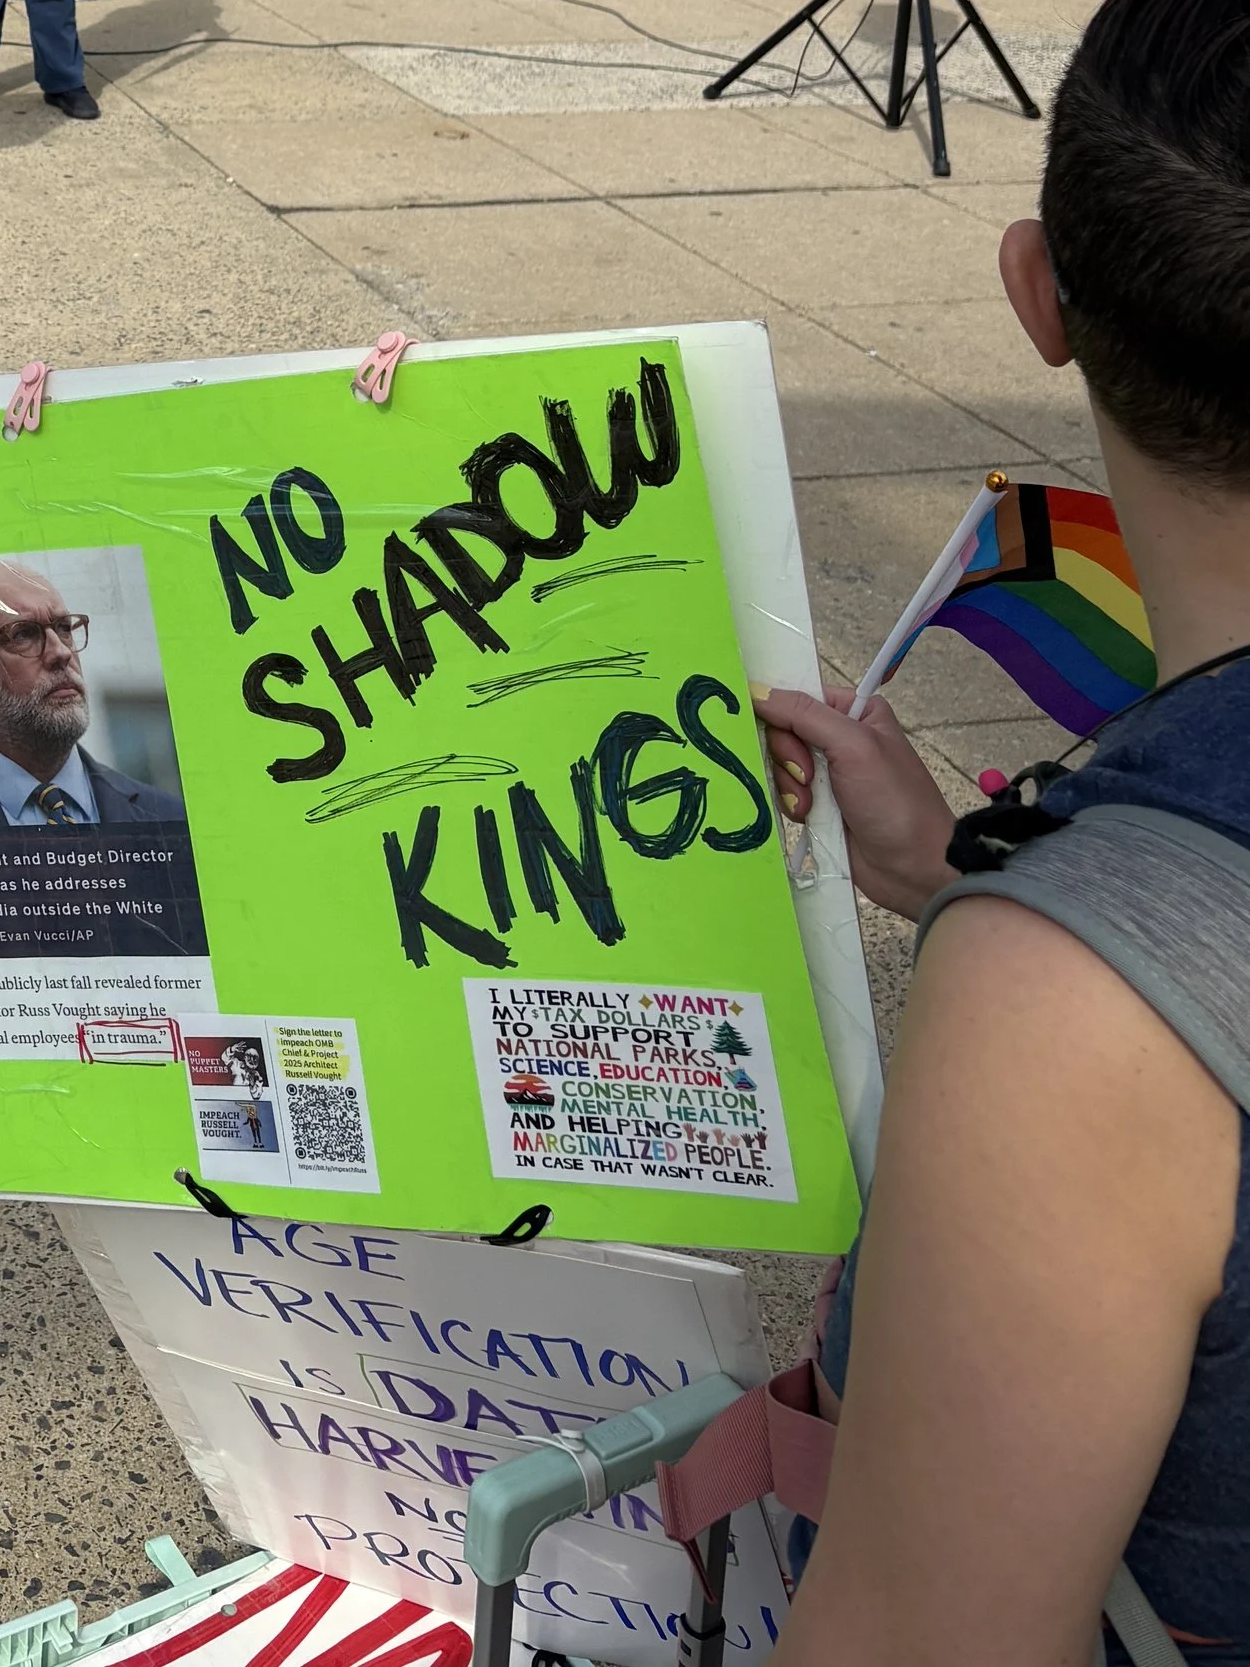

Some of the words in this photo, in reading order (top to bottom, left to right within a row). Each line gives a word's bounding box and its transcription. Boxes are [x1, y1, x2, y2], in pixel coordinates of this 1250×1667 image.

[209, 465, 347, 635] NO
[241, 355, 681, 784] SHADOW
[382, 673, 773, 969] KINGS
[13, 852, 41, 865] and
[46, 850, 103, 867] Budget
[108, 849, 174, 863] Director
[0, 880, 17, 891] as
[22, 878, 40, 891] he
[45, 877, 127, 890] addresses
[23, 903, 81, 916] outside
[86, 902, 112, 915] the
[116, 901, 163, 914] White
[0, 931, 30, 942] Evan
[33, 929, 94, 942] Vucci/AP
[44, 975, 68, 989] last
[70, 975, 92, 990] fall
[94, 975, 151, 989] revealed
[154, 975, 202, 989] former
[17, 1003, 50, 1017] Russ
[52, 1003, 101, 1020] Vought
[104, 1003, 148, 1020] saying
[150, 1002, 166, 1016] he
[488, 988, 500, 1003] I
[510, 989, 630, 1009] LITERALLY
[653, 993, 729, 1016] WANT
[492, 1006, 526, 1020] MY
[599, 1009, 701, 1031] DOLLARS
[11, 1030, 81, 1047] employees
[279, 1027, 297, 1037] Sign
[297, 1027, 311, 1036] the
[311, 1028, 333, 1037] letter
[333, 1030, 343, 1038] to
[493, 1021, 534, 1038] TO
[551, 1023, 695, 1047] SUPPORT
[314, 1039, 334, 1048] OMB
[190, 1058, 220, 1066] PUPPET
[281, 1048, 303, 1058] Chief
[303, 1049, 311, 1057] &
[311, 1050, 339, 1060] Project
[496, 1038, 620, 1061] NATIONAL
[633, 1045, 723, 1071] PARKS,
[191, 1065, 229, 1074] MASTERS
[284, 1059, 303, 1068] 2025
[303, 1060, 338, 1069] Architect
[285, 1070, 313, 1079] Russell
[313, 1071, 342, 1082] Vought
[561, 1080, 765, 1115] CONSERVATION,
[199, 1111, 240, 1120] IMPEACH
[560, 1098, 655, 1119] MENTAL
[665, 1106, 767, 1131] HEALTH,
[201, 1120, 239, 1129] RUSSELL
[510, 1111, 555, 1131] AND
[569, 1116, 682, 1140] HELPING
[202, 1129, 243, 1139] VOUGHT.
[513, 1131, 678, 1163] MARGINALIZED
[685, 1146, 772, 1171] PEOPLE.
[515, 1154, 535, 1167] IN
[541, 1157, 584, 1172] CASE
[590, 1158, 633, 1175] THAT
[641, 1163, 704, 1180] WASN'T
[712, 1169, 774, 1189] CLEAR.
[233, 1215, 406, 1281] AGE
[154, 1249, 690, 1397] VERIFICATION
[278, 1360, 345, 1396] IS
[369, 1367, 607, 1436] DAT
